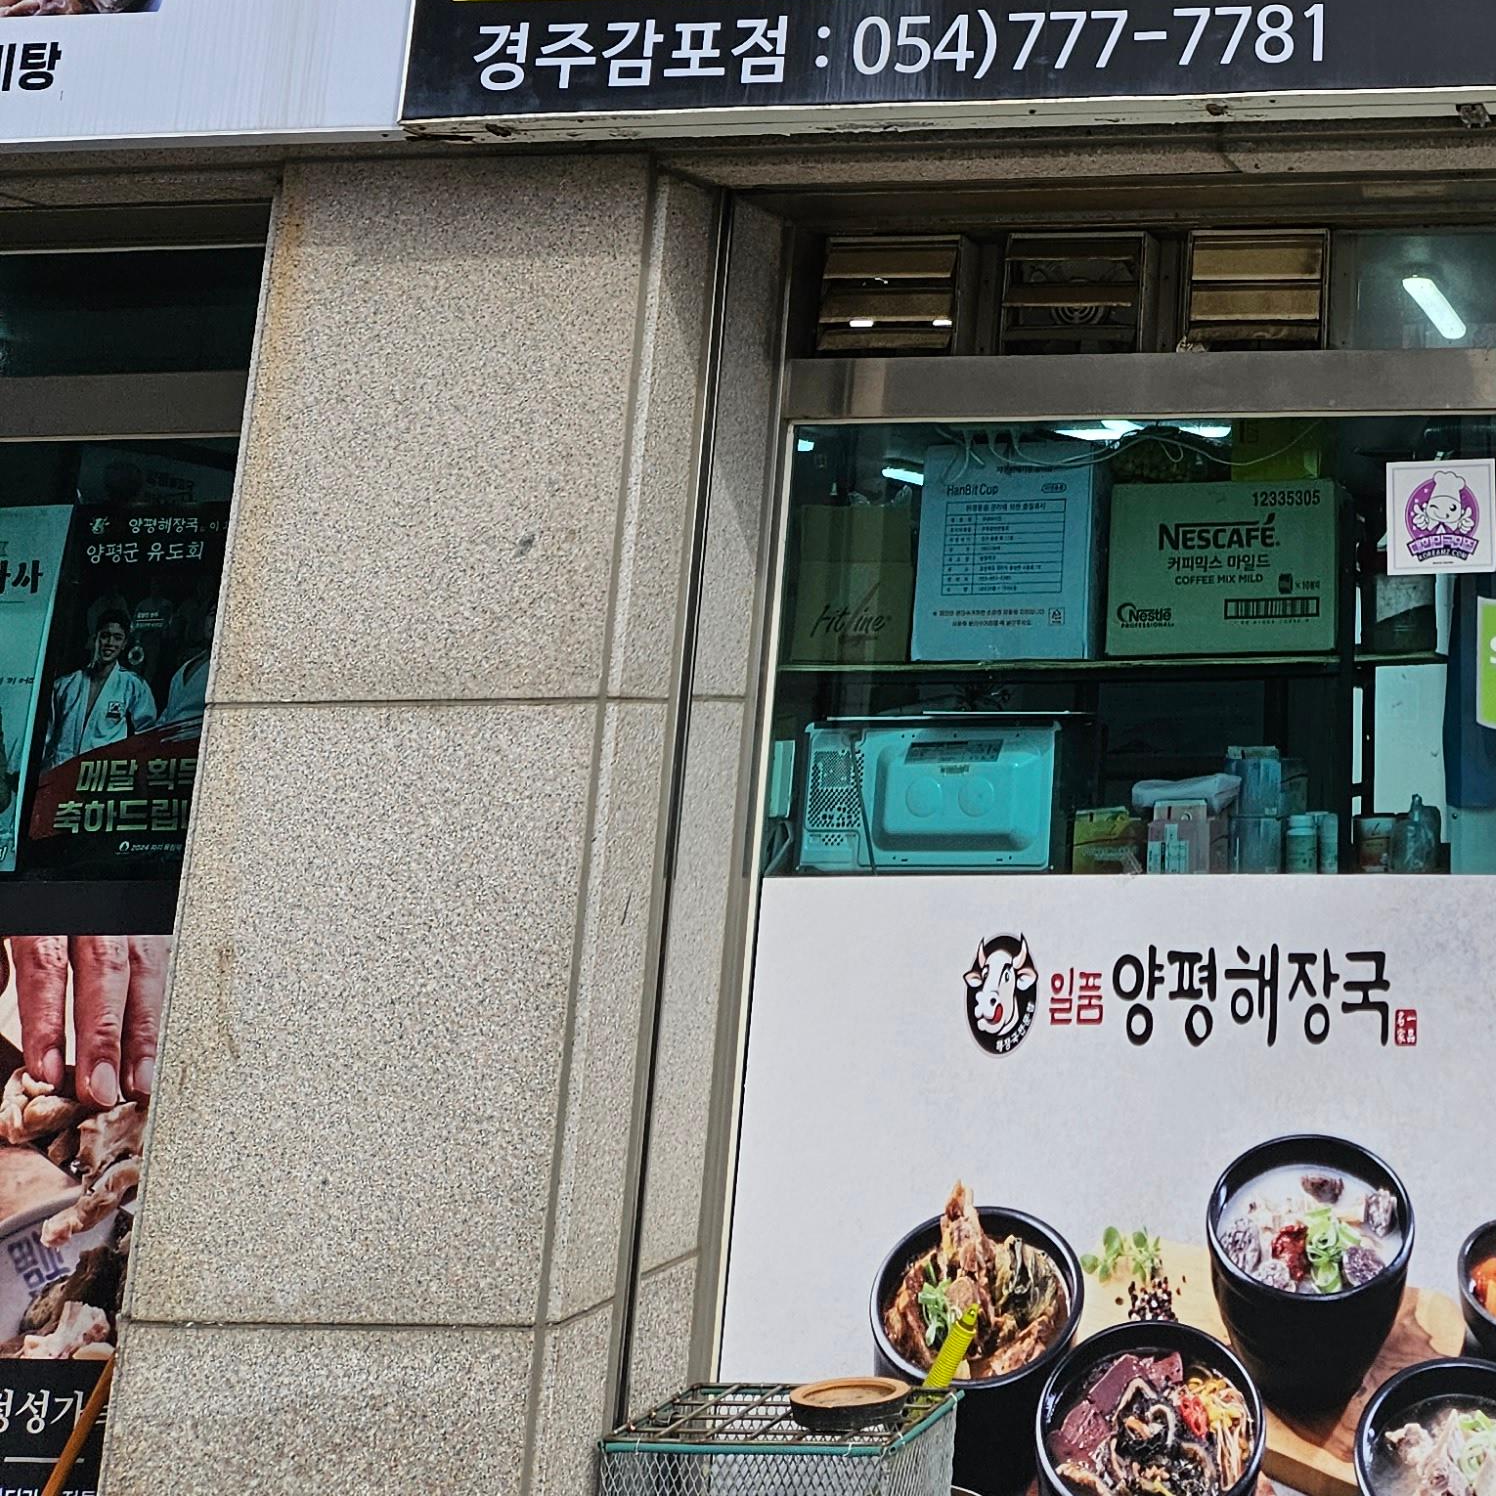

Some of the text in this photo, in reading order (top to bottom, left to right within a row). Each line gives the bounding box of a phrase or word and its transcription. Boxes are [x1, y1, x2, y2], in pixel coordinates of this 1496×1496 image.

[472, 14, 789, 92] 경주감포점
[852, 3, 1327, 80] 054)777-7781
[979, 483, 999, 496] Cup
[1252, 490, 1320, 506] 12335305
[128, 517, 199, 534] 양평해장국
[86, 540, 204, 564] 양평군 유도회
[1168, 554, 1271, 572] 커피믹스 마일드
[1174, 573, 1264, 585] COFFEE MIX MILD
[76, 759, 138, 792] 메달
[1049, 943, 1391, 1048] 일품 양평해장국
